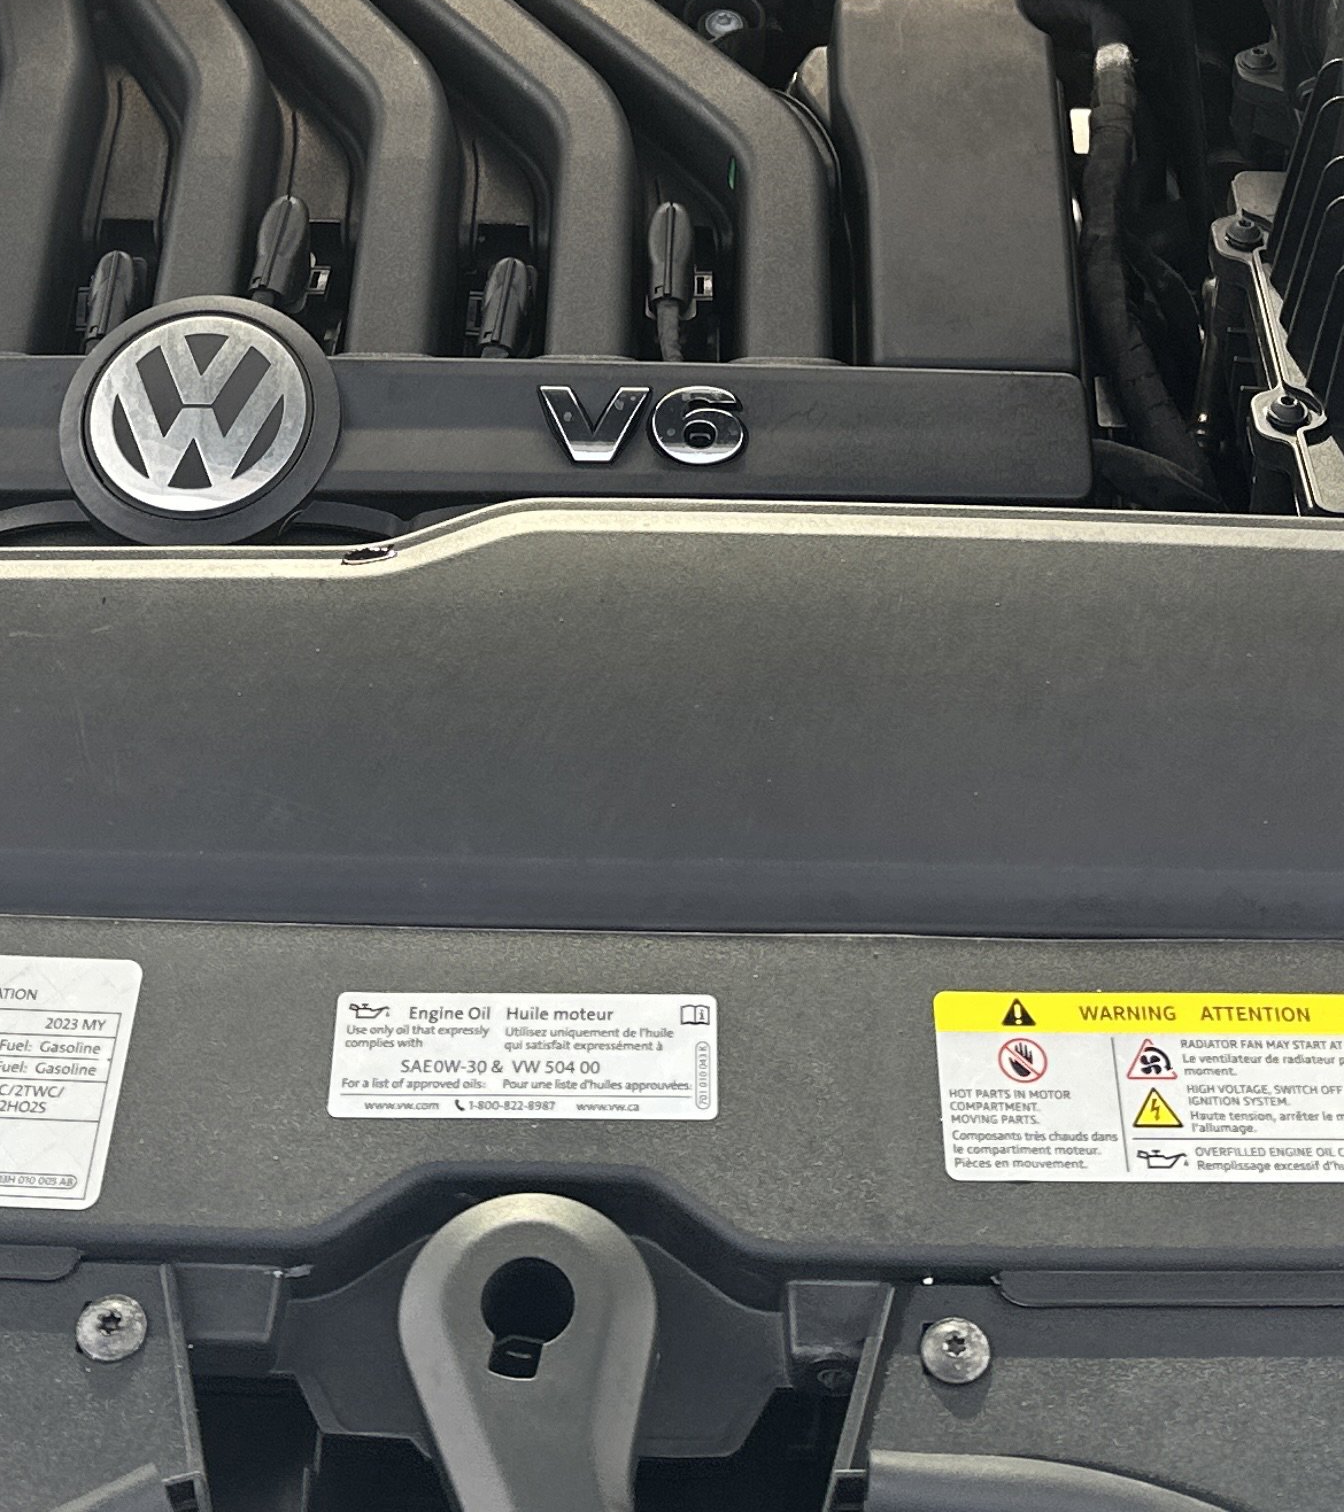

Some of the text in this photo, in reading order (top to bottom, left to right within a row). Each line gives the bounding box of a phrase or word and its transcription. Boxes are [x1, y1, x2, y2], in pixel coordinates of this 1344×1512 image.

[537, 384, 749, 466] V6
[409, 1006, 614, 1023] Engine Oil Huile moteur
[1079, 1005, 1311, 1022] WARNING ATTENTION
[45, 1018, 106, 1032] 2023 MY
[346, 1025, 490, 1038] Use only oil that expressly
[505, 1027, 674, 1040] Utilisez uniquement de l'huile
[39, 1041, 101, 1055] Gasoline
[345, 1038, 423, 1050] complies with
[504, 1040, 653, 1052] qui satisfait expressément
[1180, 1039, 1237, 1049] RADIATOR
[1241, 1040, 1263, 1049] FAN
[1266, 1040, 1289, 1050] MAY
[1292, 1040, 1326, 1050] START
[1199, 1054, 1262, 1064] ventilateur
[1265, 1054, 1279, 1064] de
[1283, 1054, 1335, 1064] radiateur
[35, 1062, 97, 1077] Gasoline
[491, 1060, 504, 1073] &
[512, 1061, 541, 1073] VW
[545, 1061, 575, 1073] 504
[580, 1061, 600, 1074] 00
[1184, 1067, 1237, 1076] moment.
[342, 1078, 486, 1091] For list approved oils:
[503, 1079, 622, 1090] Pour une liste d'huiles
[1187, 1085, 1215, 1094] HIGH
[1218, 1085, 1272, 1095] VOLTAGE,
[1275, 1085, 1318, 1095] SWITCH
[1321, 1085, 1342, 1095] OFF
[949, 1089, 1071, 1100] HOT PARTS MOTOR
[364, 1100, 640, 1112] www.vw.com 1-800-822-8987 www.vw.ca
[950, 1102, 1041, 1112] COMPARTMENT.
[1189, 1096, 1291, 1106] IGNITION SYSTEM.
[951, 1115, 1040, 1125] MOVING PARTS.
[1190, 1111, 1226, 1121] Haute
[1229, 1112, 1276, 1122] tension,
[1279, 1111, 1320, 1121] arrêter
[1192, 1122, 1257, 1134] l'allumage.
[952, 1130, 1118, 1142] Composants très chauds dans
[967, 1145, 1102, 1156] compartiment moteur.
[1195, 1147, 1266, 1157] OVERFILLED
[1269, 1147, 1312, 1157] ENGINE
[1316, 1147, 1335, 1157] OIL
[955, 1157, 1088, 1169] Pièces mouvement.
[1197, 1160, 1271, 1173] Remplissage
[1274, 1160, 1320, 1171] excessif
